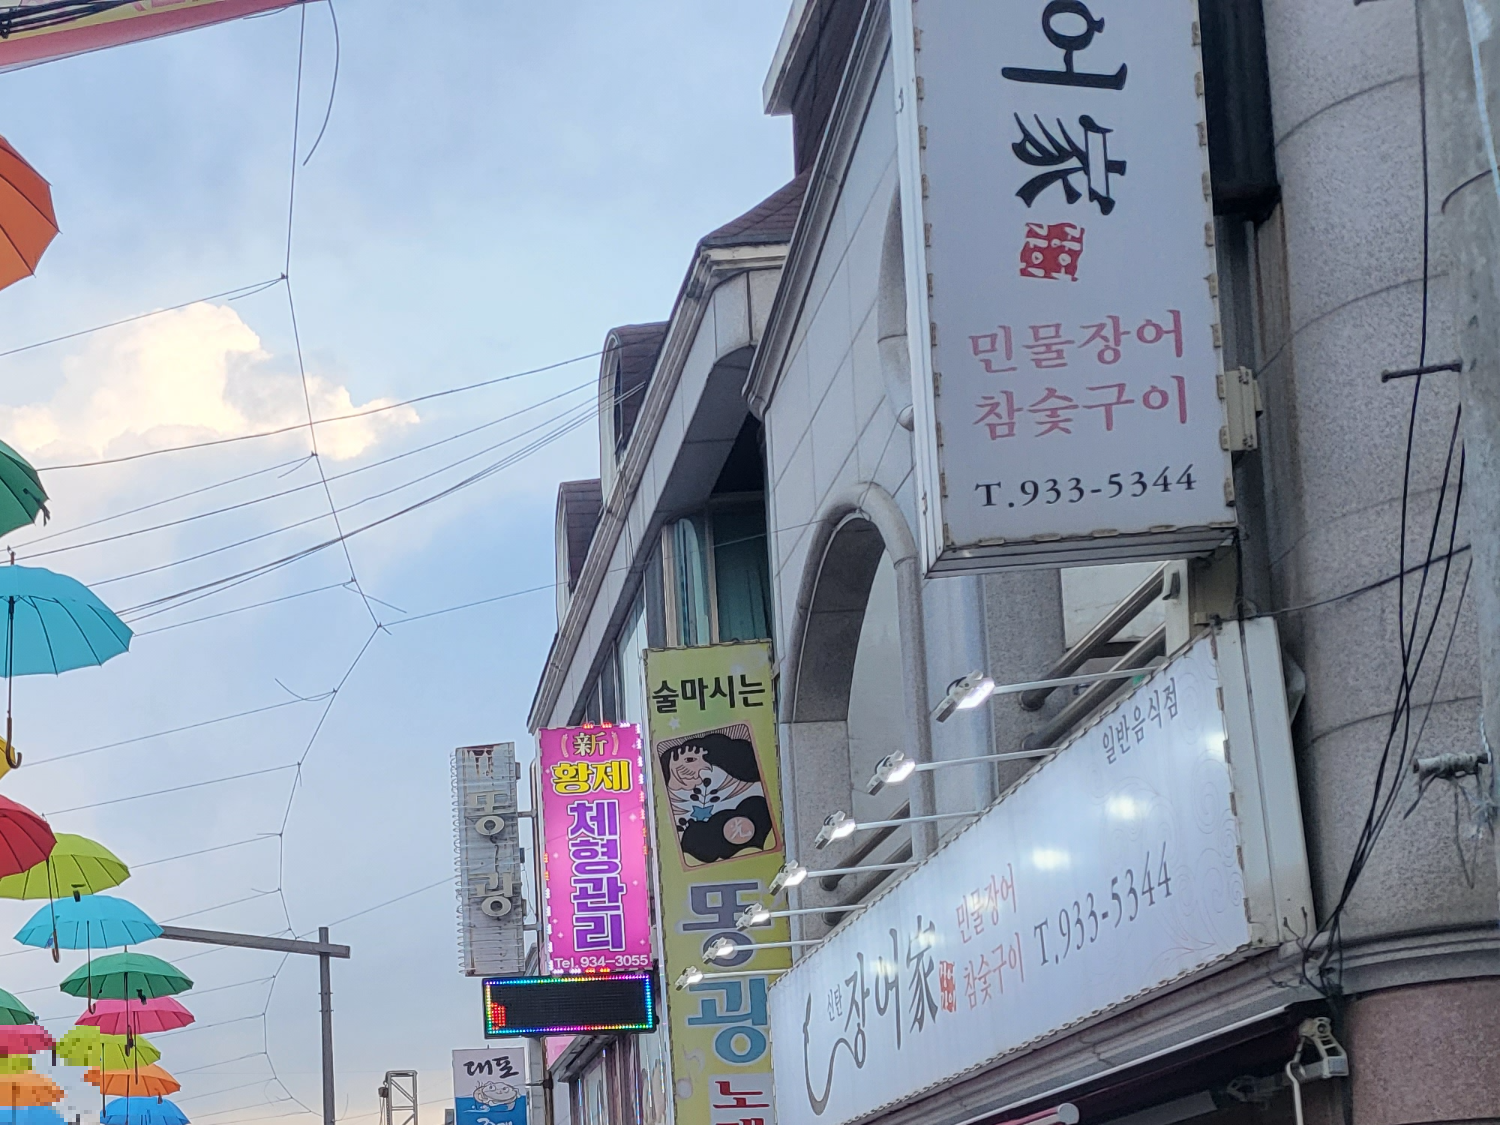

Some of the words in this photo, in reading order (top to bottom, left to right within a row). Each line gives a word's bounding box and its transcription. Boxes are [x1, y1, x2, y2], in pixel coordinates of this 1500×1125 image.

[969, 309, 1185, 375] 민물장어
[972, 375, 1189, 440] 참숯구이
[975, 464, 1198, 509] T.933-5344
[652, 674, 767, 714] 술마시는
[1102, 677, 1179, 765] 일반음식점
[551, 759, 633, 795] 황제
[573, 732, 607, 757] 新
[567, 798, 627, 953] 체형관리
[955, 862, 1017, 944] 민물장어
[963, 931, 1025, 1010] 참숯구이
[1033, 841, 1172, 966] T.933-5344
[826, 983, 843, 1022] 신탄
